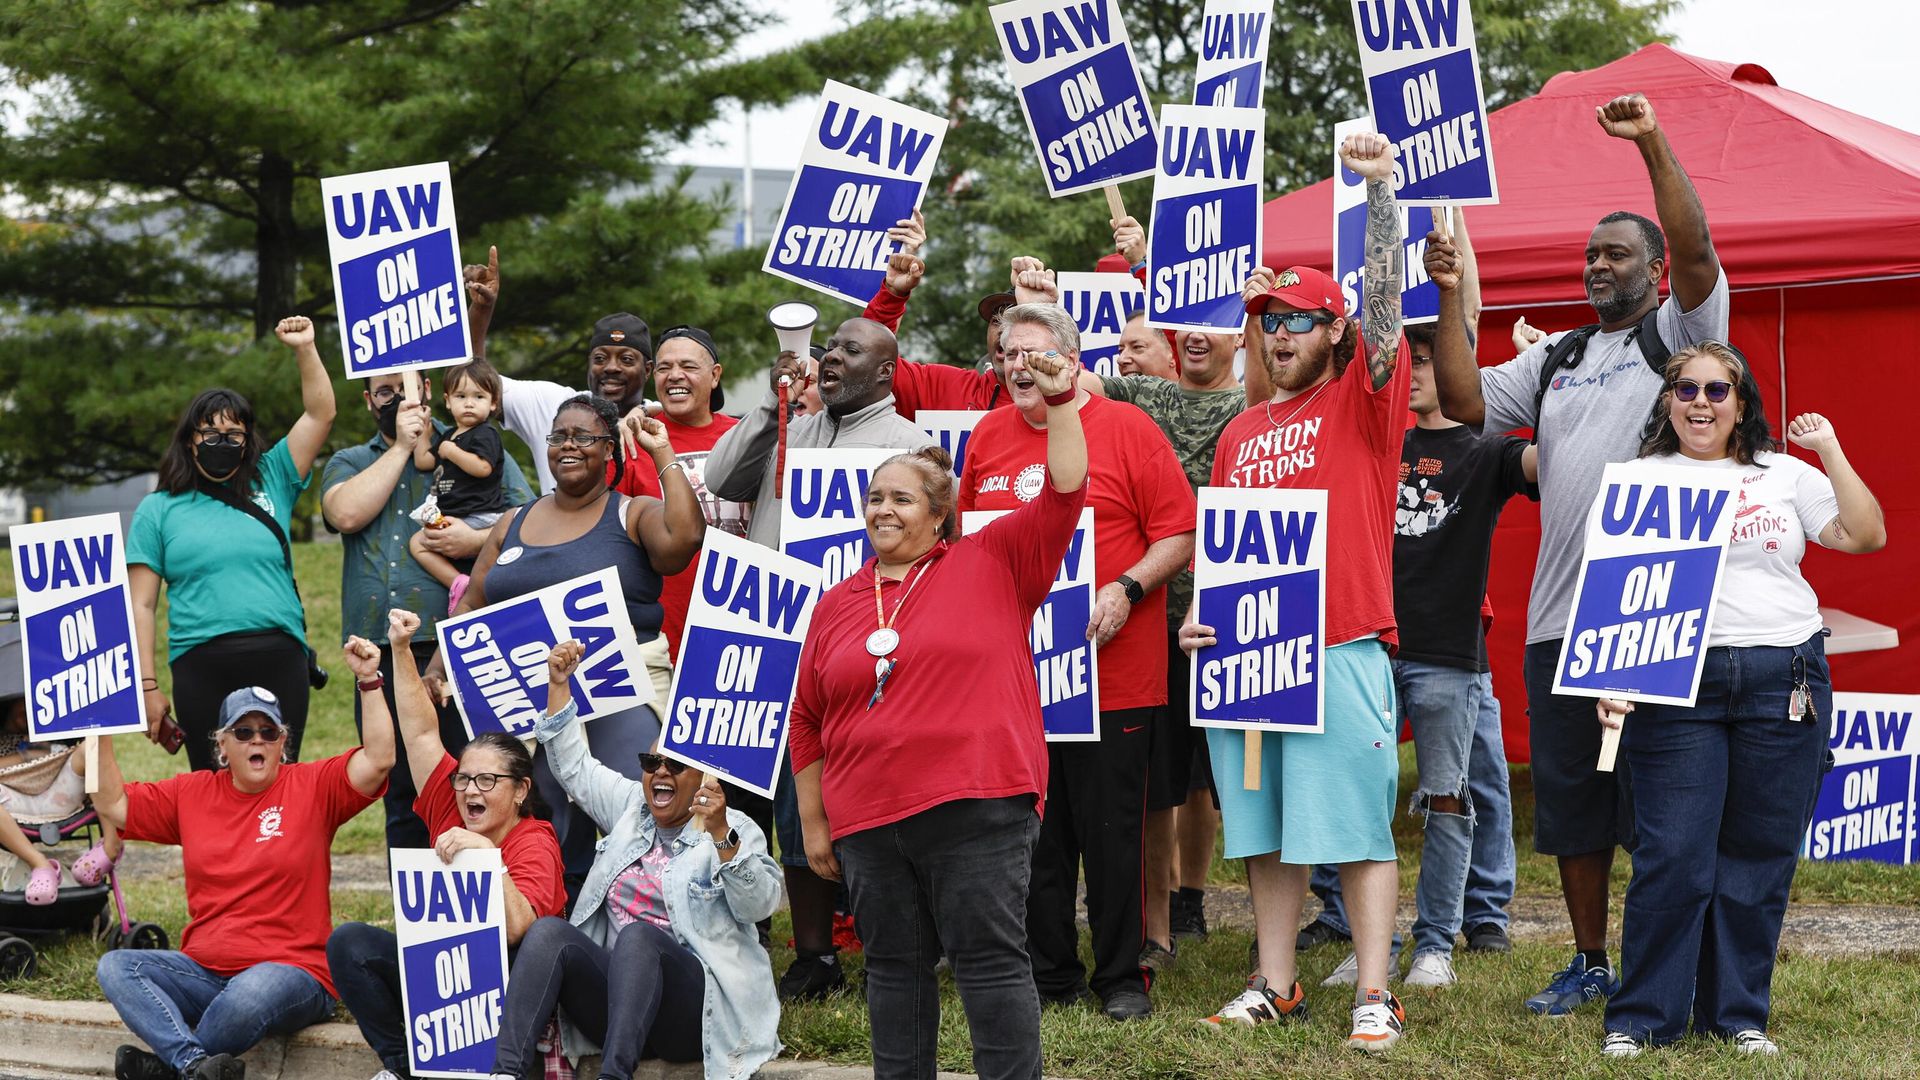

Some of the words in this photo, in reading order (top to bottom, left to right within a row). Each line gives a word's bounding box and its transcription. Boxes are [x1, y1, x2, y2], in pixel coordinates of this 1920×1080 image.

[1002, 0, 1111, 64] UAW
[1203, 12, 1266, 61] UAW
[1358, 0, 1459, 52] UAW
[1060, 66, 1104, 121] ON
[1402, 69, 1441, 127] ON
[818, 100, 935, 177] UAW
[1047, 95, 1148, 183] STRIKE
[1162, 126, 1256, 181] UAW
[1393, 110, 1481, 192] STRIKE
[332, 181, 442, 239] UAW
[828, 182, 882, 224] ON
[1185, 199, 1222, 253] ON
[376, 247, 419, 302] ON
[778, 224, 896, 272] STRIKE
[1154, 244, 1251, 314] STRIKE
[351, 281, 458, 364] STRIKE
[1236, 416, 1322, 467] UNION
[978, 475, 1010, 494] LOCAL
[1024, 478, 1043, 488] UAW
[1601, 483, 1730, 542] UAW
[19, 533, 113, 592] UAW
[822, 538, 863, 592] ON
[1204, 508, 1316, 566] UAW
[702, 549, 811, 636] UAW
[1236, 585, 1280, 646] ON
[1620, 562, 1673, 617] ON
[59, 604, 97, 662] ON
[562, 580, 637, 699] UAW
[1029, 602, 1054, 656] N
[1568, 607, 1702, 681] STRIKE
[35, 642, 132, 727] STRIKE
[451, 622, 540, 733] STRIKE
[509, 640, 551, 689] ON
[715, 644, 763, 693] ON
[1035, 645, 1088, 708] IKE
[1200, 633, 1314, 711] STRIKE
[671, 696, 783, 749] STRIKE
[1829, 709, 1913, 751] UAW
[1843, 765, 1880, 811] ON
[1813, 801, 1904, 860] STRIKE
[397, 870, 492, 923] UAW
[434, 942, 472, 1000] ON
[414, 988, 503, 1063] STRIKE
